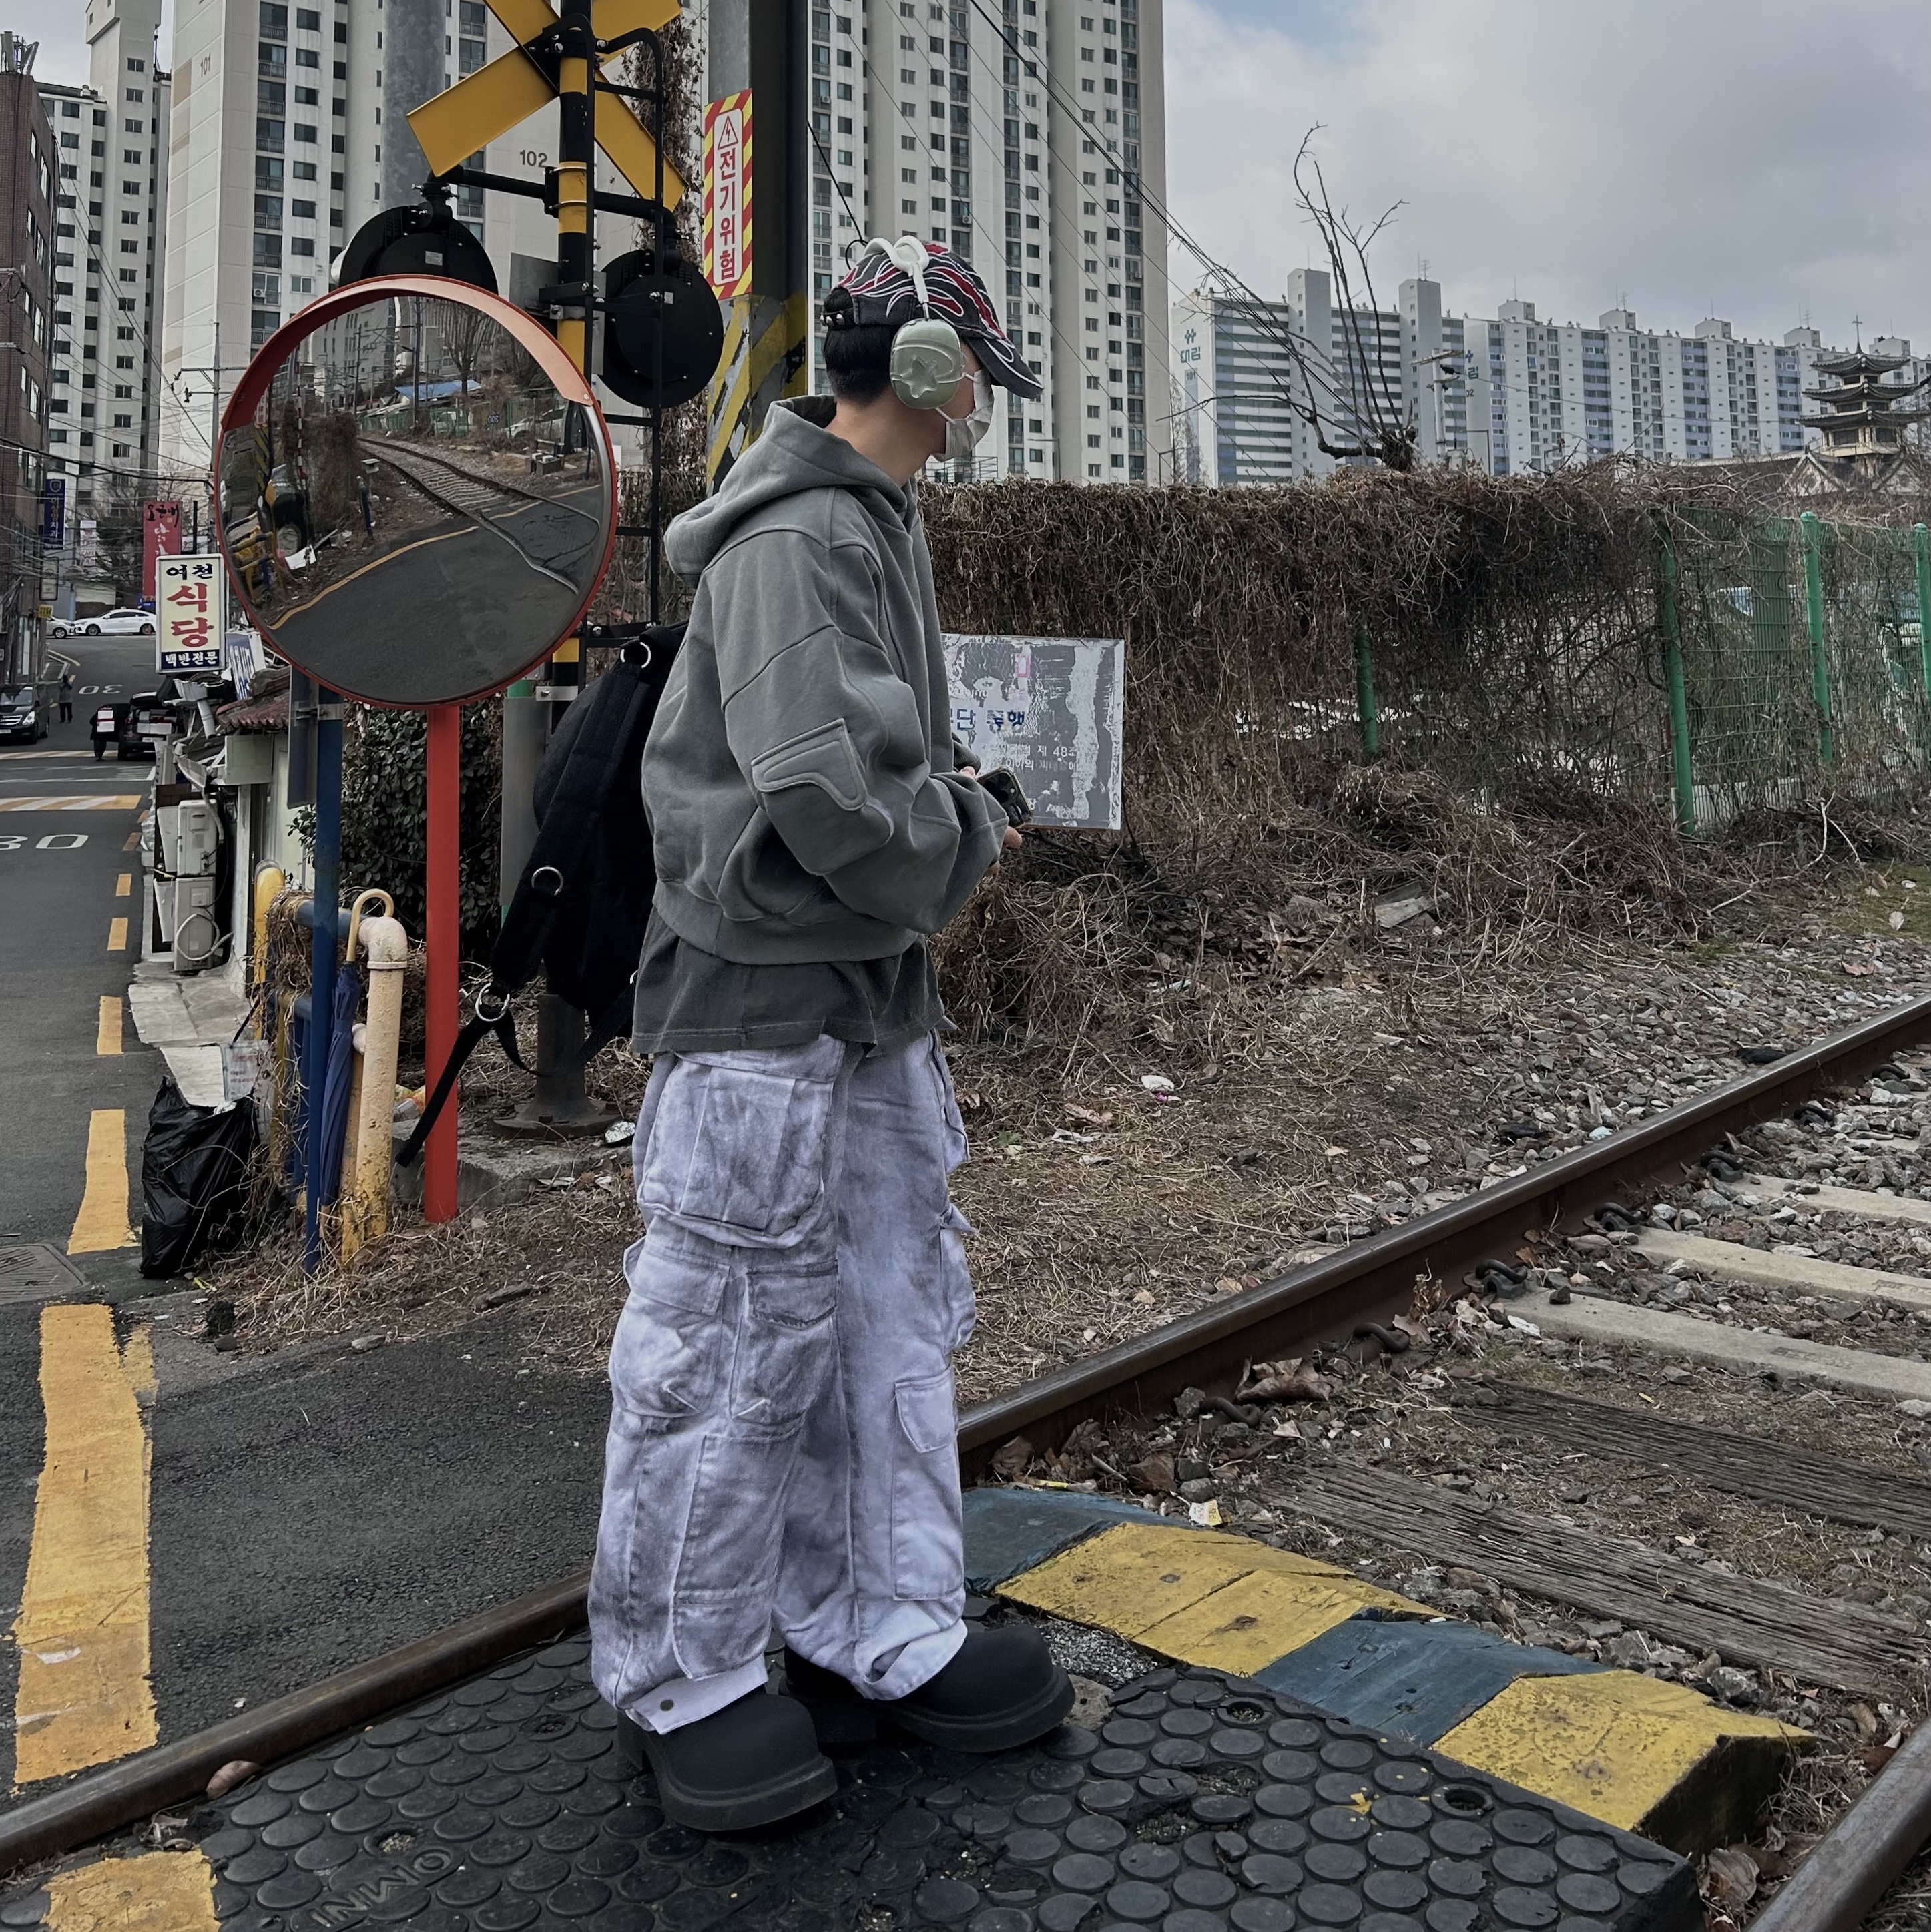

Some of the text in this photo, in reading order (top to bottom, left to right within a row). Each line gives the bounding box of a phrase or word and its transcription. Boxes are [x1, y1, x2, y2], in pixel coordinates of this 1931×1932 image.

[200, 53, 211, 77] 101
[519, 149, 547, 168] 102
[719, 147, 736, 280] 전기위험
[1181, 346, 1201, 364] 대림
[1187, 371, 1196, 381] 101
[1465, 366, 1478, 380] 림
[1466, 389, 1474, 398] 02
[166, 563, 212, 580] 여천
[166, 582, 214, 647] 식당
[165, 651, 218, 667] 백반전문
[79, 685, 122, 695] 30
[950, 709, 976, 731] 단
